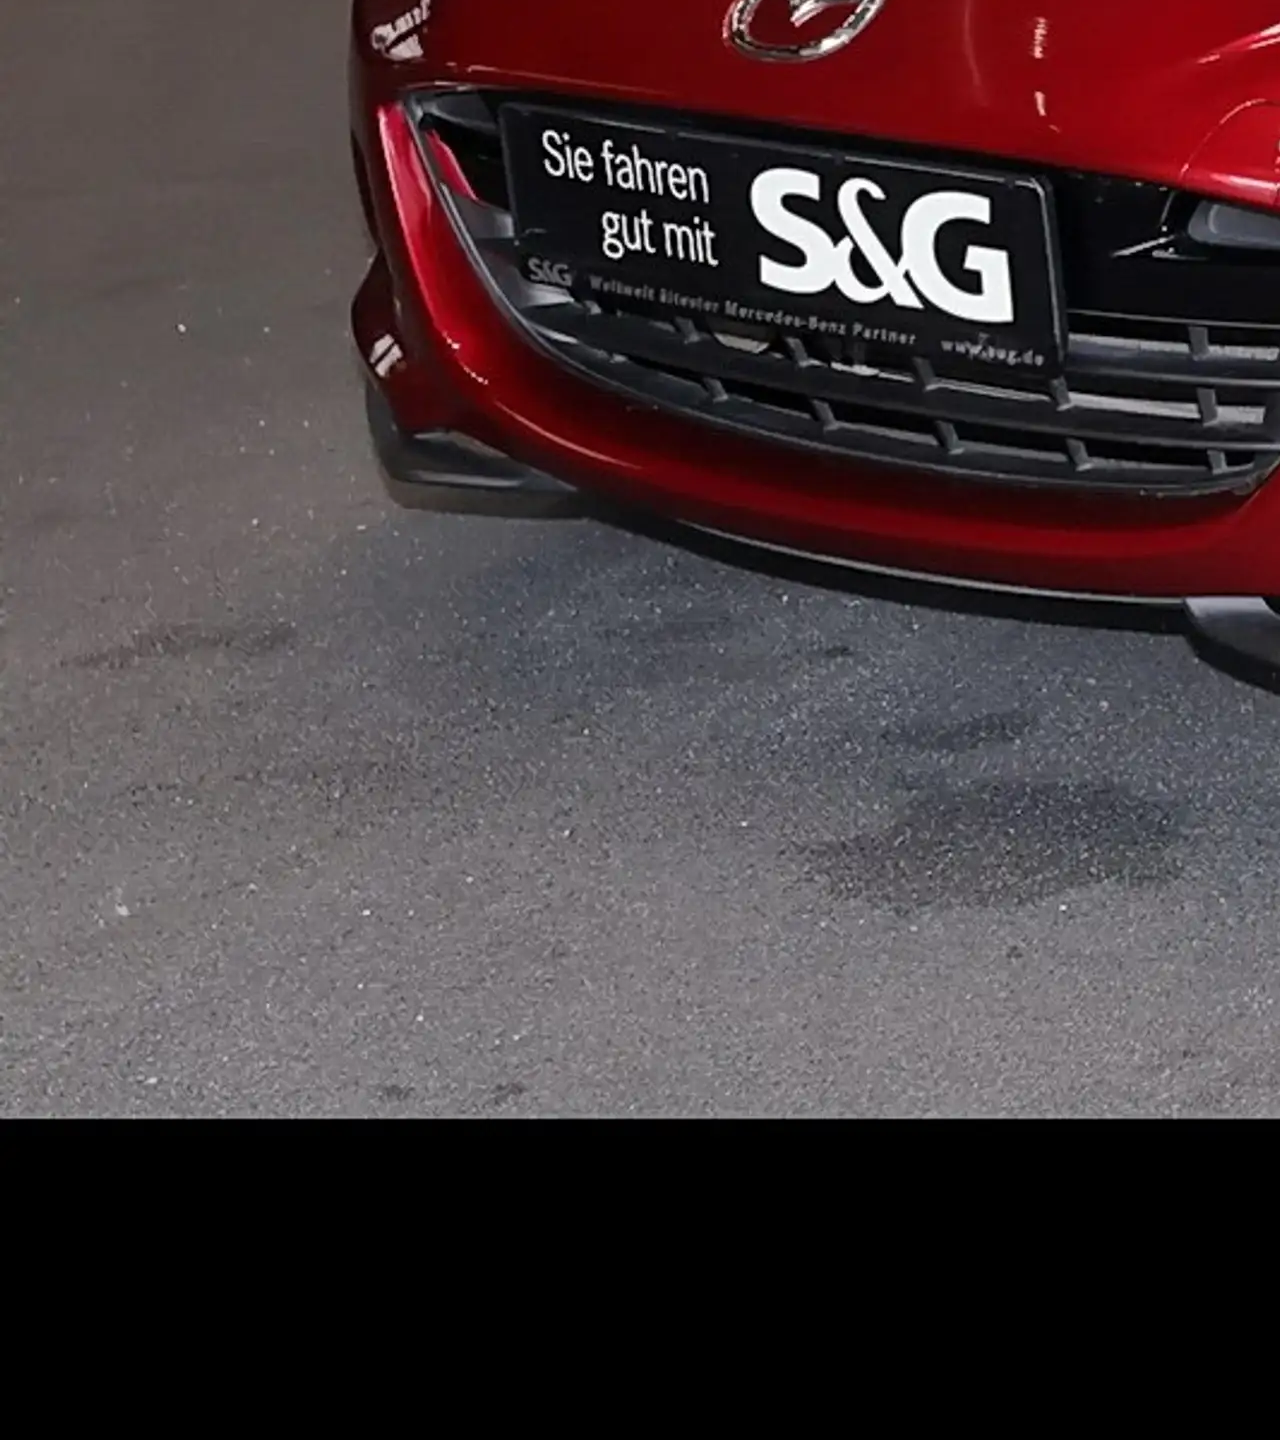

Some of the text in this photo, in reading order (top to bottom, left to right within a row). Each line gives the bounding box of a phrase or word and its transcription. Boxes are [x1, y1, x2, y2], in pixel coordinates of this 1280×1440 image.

[542, 129, 710, 204] Sie fahren
[602, 209, 719, 267] gut mit
[750, 167, 1014, 323] S&G
[724, 300, 847, 336] Mercedes-Benz
[852, 322, 917, 346] Partner
